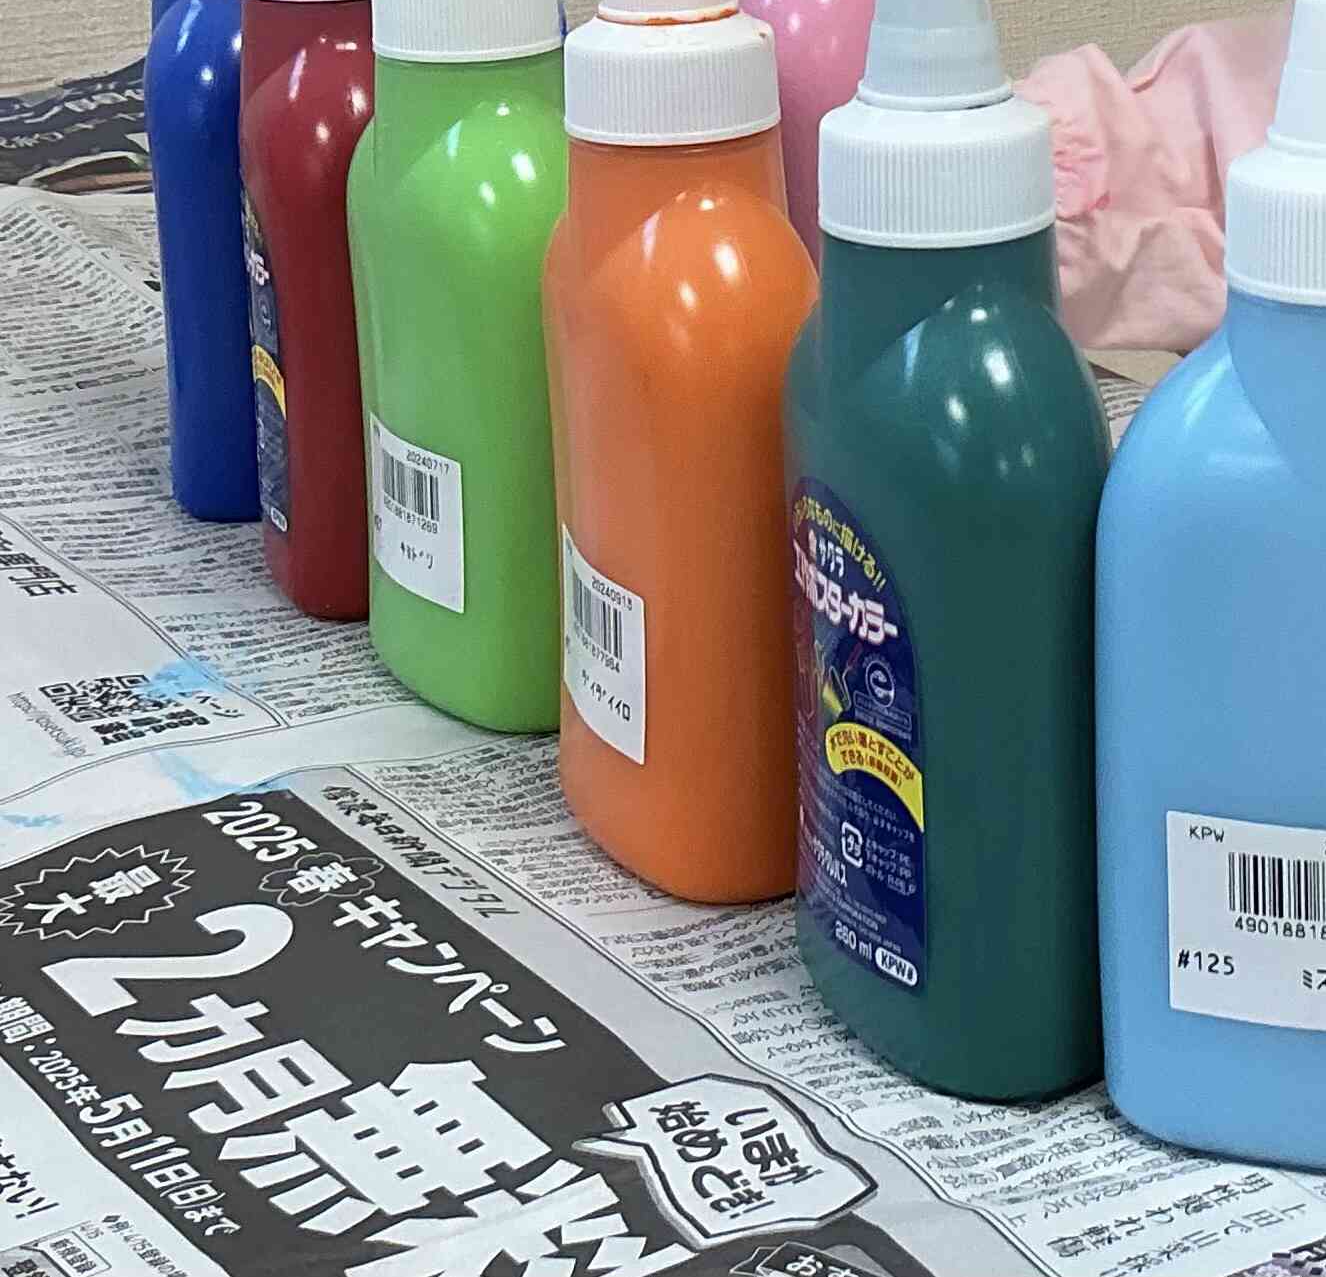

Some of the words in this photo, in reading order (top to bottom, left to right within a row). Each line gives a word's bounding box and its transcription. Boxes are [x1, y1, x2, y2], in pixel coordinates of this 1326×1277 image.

[1189, 825, 1225, 843] KPW
[24, 862, 146, 926] 最大
[202, 798, 302, 867] 2025
[288, 860, 359, 911] 春
[332, 895, 566, 1056] キャンペーン
[1177, 950, 1235, 975] #125
[725, 1107, 824, 1186] いまが
